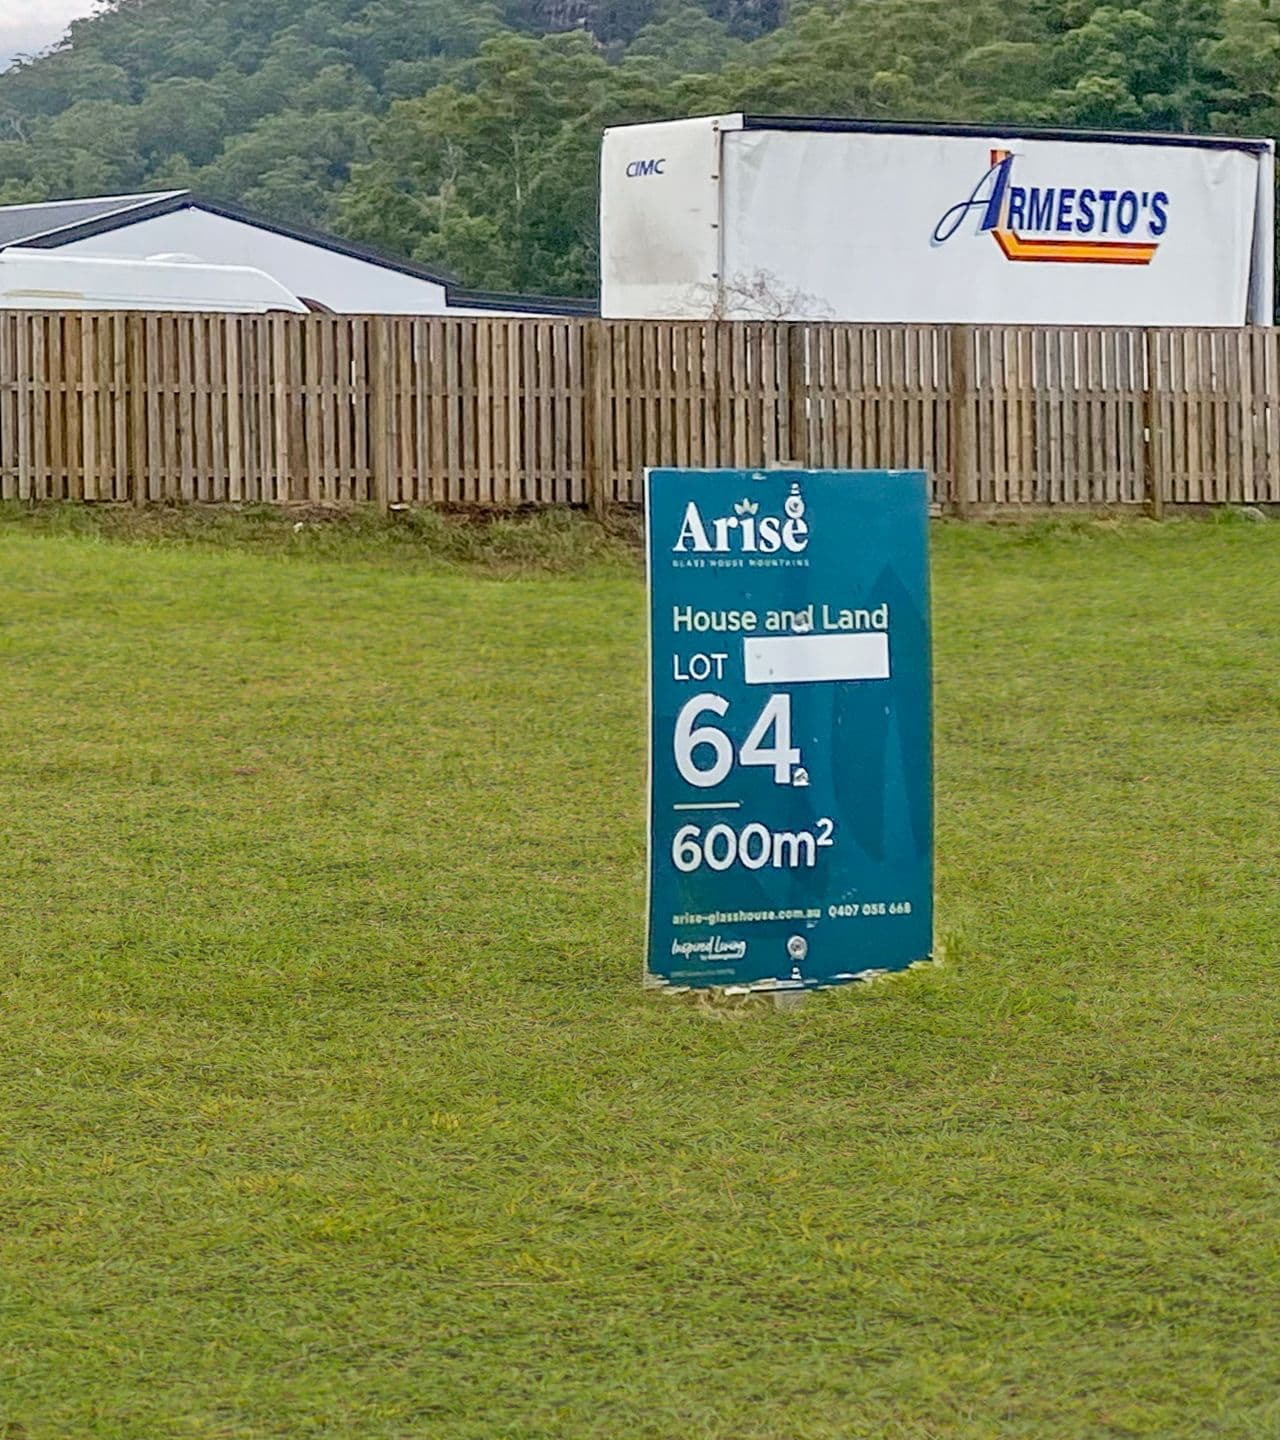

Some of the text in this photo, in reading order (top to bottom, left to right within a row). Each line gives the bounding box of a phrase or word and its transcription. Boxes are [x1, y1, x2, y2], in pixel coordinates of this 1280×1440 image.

[626, 159, 666, 178] CIMC
[672, 500, 809, 553] Arise
[673, 603, 888, 632] House and Land
[673, 653, 729, 680] LOT
[674, 693, 801, 788] 64
